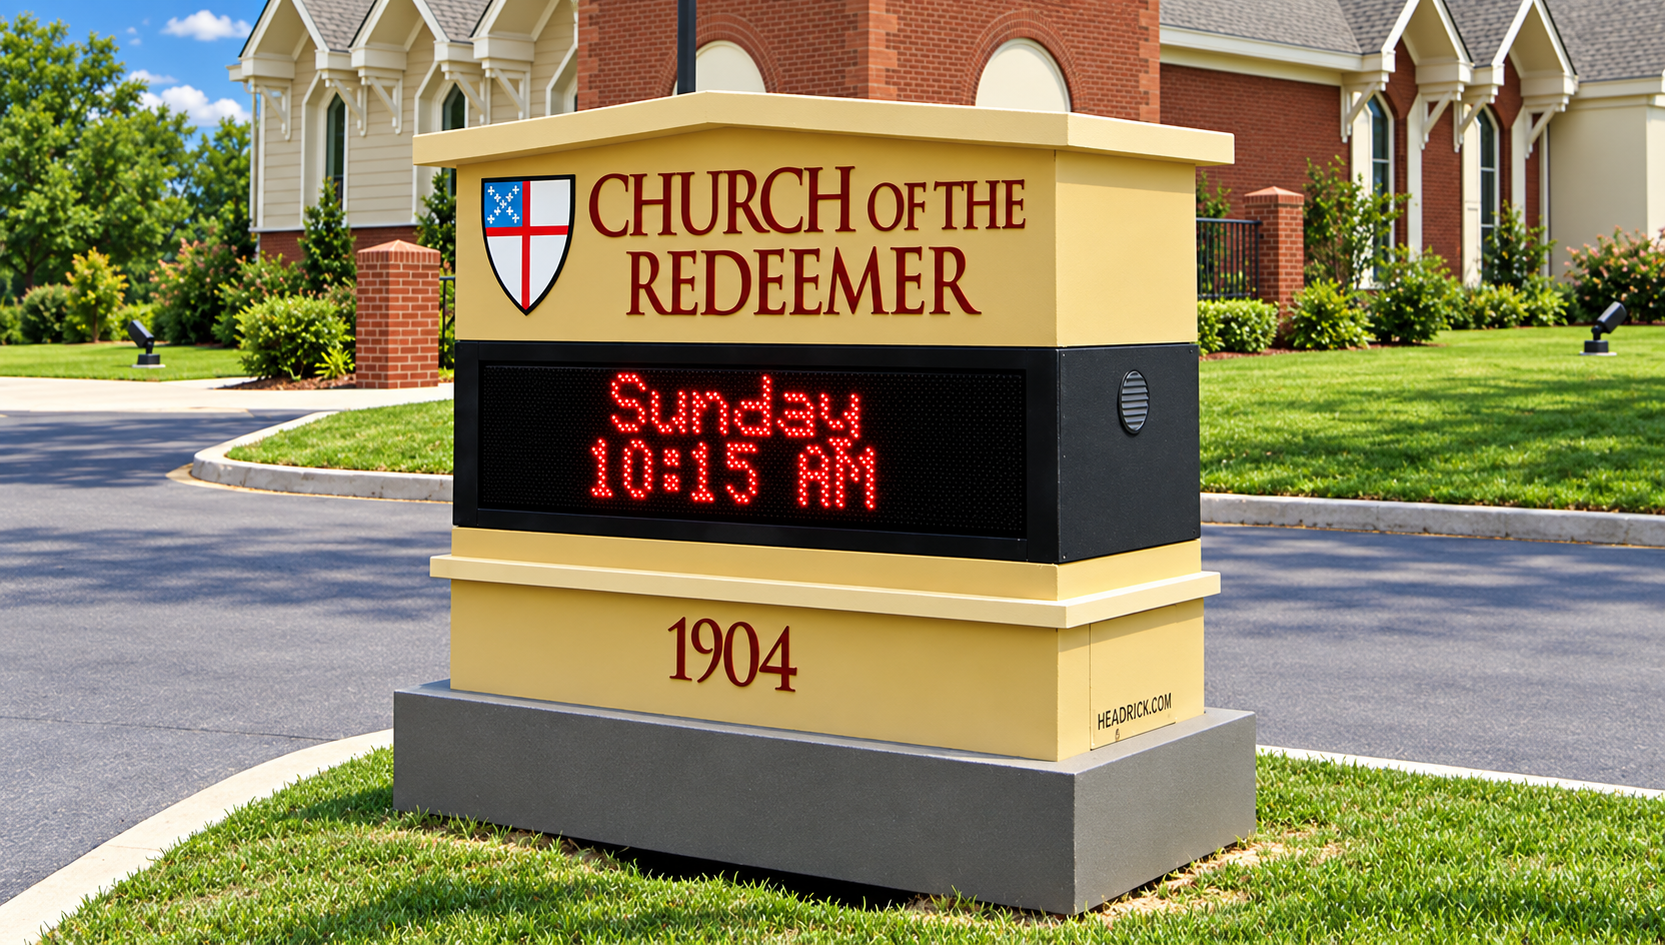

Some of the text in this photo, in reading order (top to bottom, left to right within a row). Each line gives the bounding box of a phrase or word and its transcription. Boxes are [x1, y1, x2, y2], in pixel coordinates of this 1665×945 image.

[589, 166, 1026, 237] CHURCH OF THE
[626, 245, 982, 316] REDEEMER
[609, 372, 861, 439] Sunday
[590, 437, 876, 511] 10:15 AM
[668, 616, 798, 693] 1904
[1097, 692, 1172, 730] HEADRICK.COM
